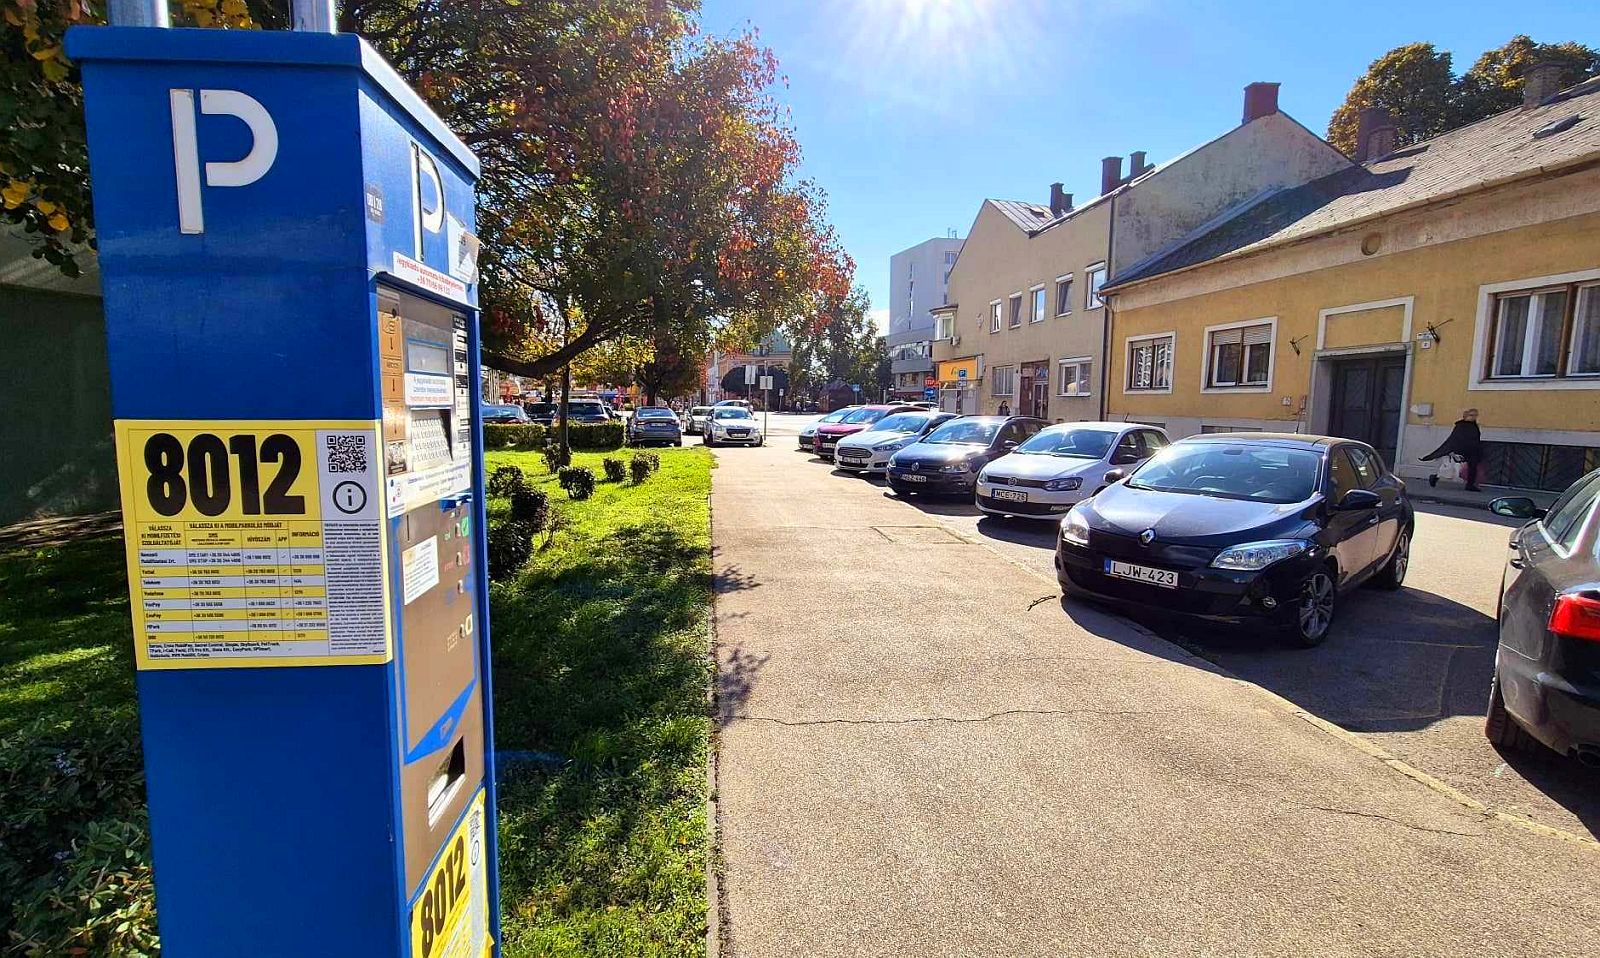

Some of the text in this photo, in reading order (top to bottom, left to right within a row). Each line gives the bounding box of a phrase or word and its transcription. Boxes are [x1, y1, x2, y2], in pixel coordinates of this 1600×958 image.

[169, 88, 279, 234] P
[411, 141, 445, 263] P
[144, 432, 305, 517] 8012
[1113, 562, 1175, 584] LJW-423
[421, 835, 466, 958] 8012
